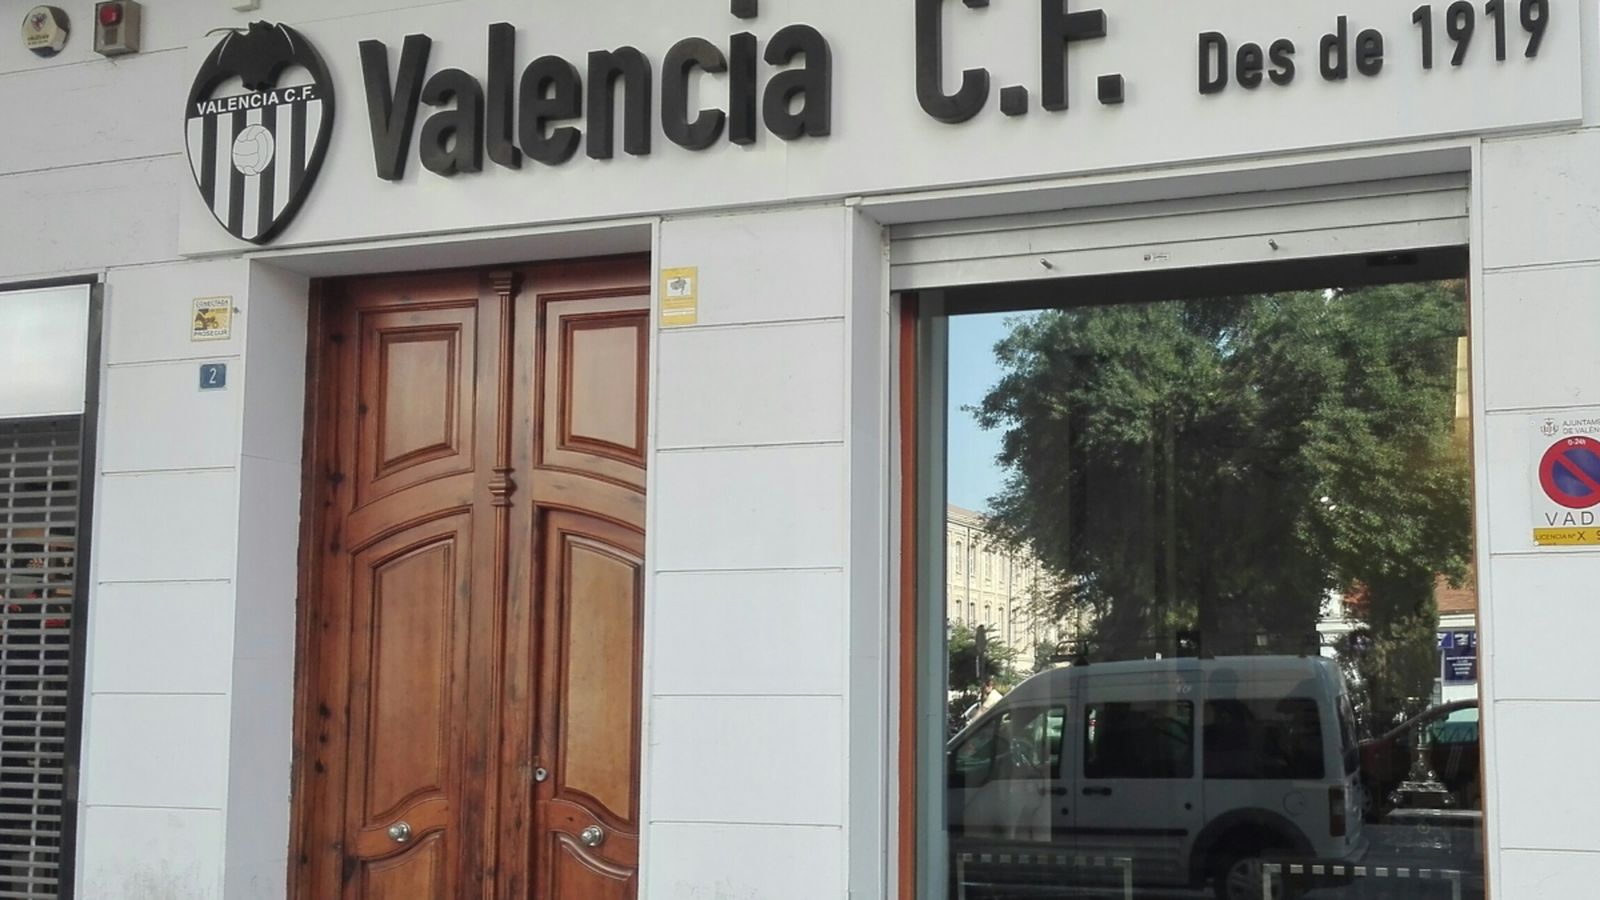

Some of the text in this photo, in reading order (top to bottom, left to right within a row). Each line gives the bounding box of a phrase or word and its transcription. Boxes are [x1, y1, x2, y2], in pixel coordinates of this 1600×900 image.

[1198, 0, 1550, 95] Des de 1919
[359, 0, 1125, 182] Valencia C.F.
[196, 86, 315, 115] VALENCIA C.F.
[208, 367, 217, 384] 2
[1562, 427, 1573, 435] DE
[1544, 511, 1595, 526] VAD
[1577, 530, 1586, 541] X
